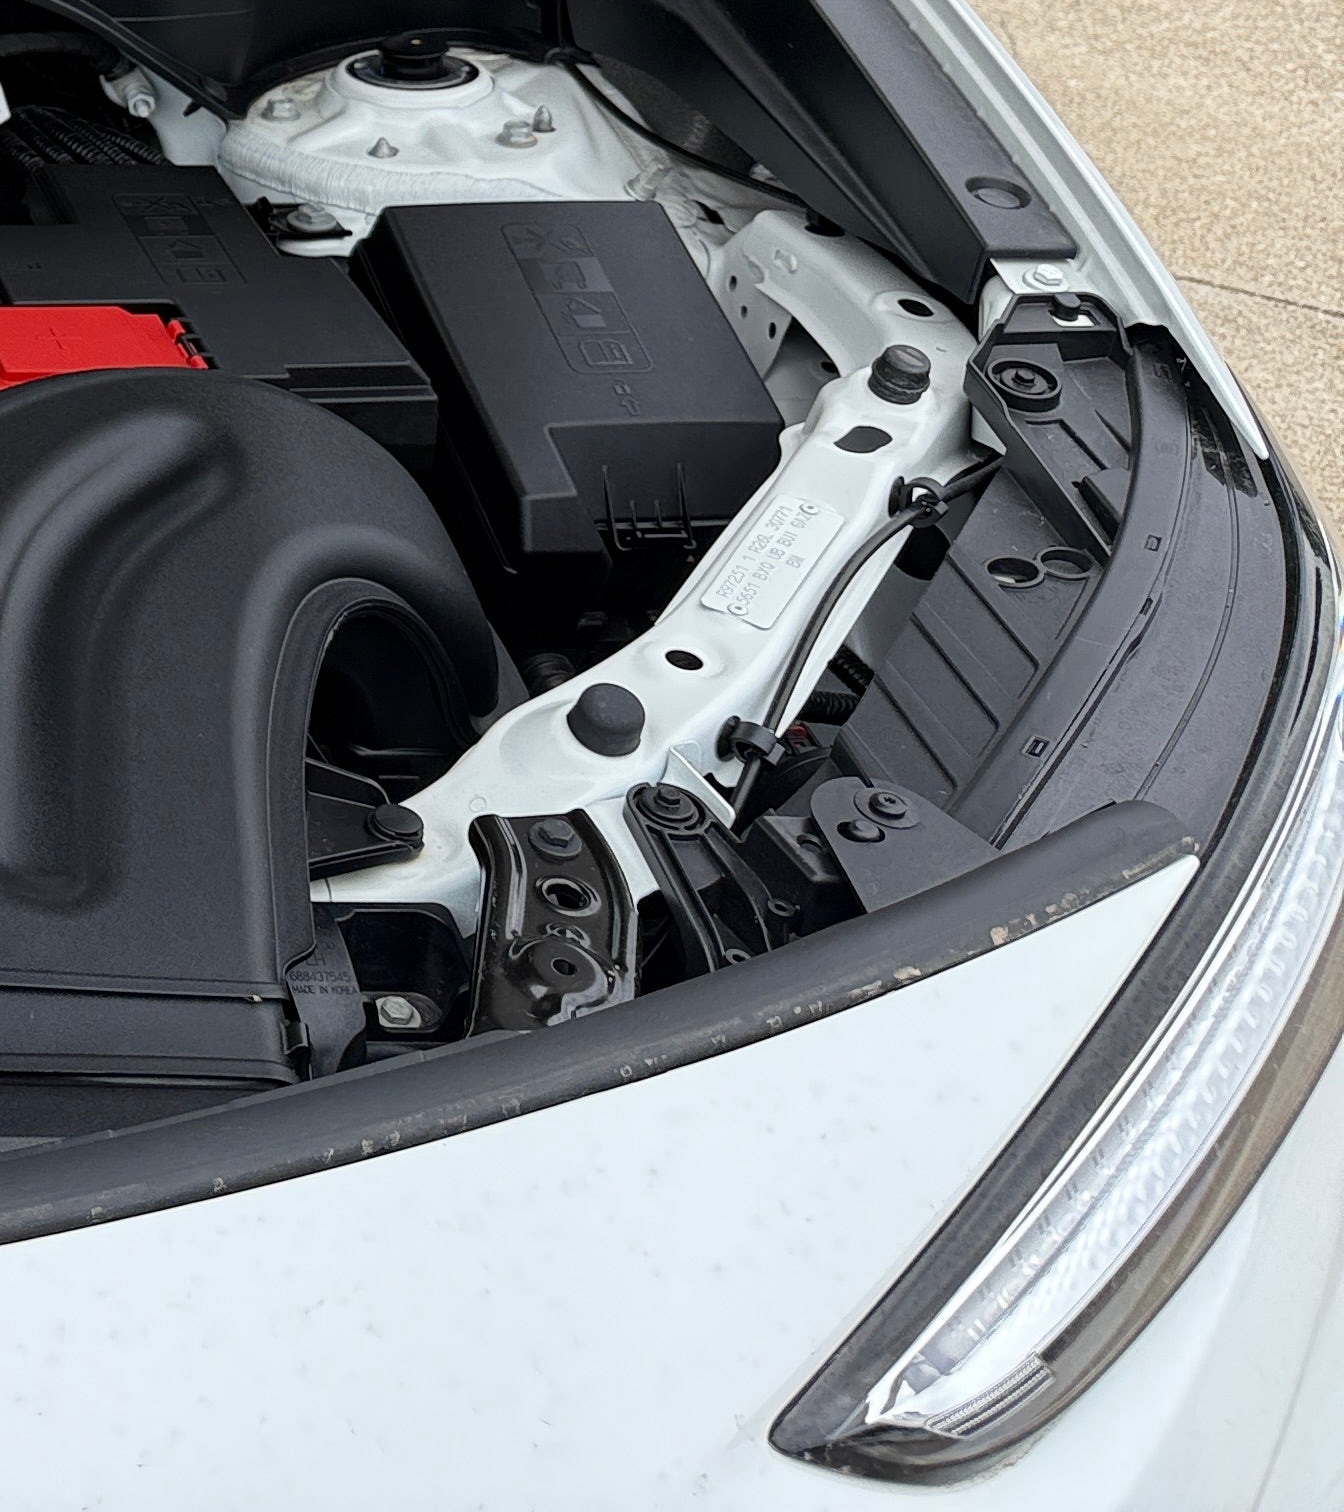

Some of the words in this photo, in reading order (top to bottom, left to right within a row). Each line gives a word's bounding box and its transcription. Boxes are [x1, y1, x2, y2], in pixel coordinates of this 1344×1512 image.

[292, 984, 315, 994] MADE
[319, 985, 329, 994] IN
[331, 985, 359, 994] KOREA
